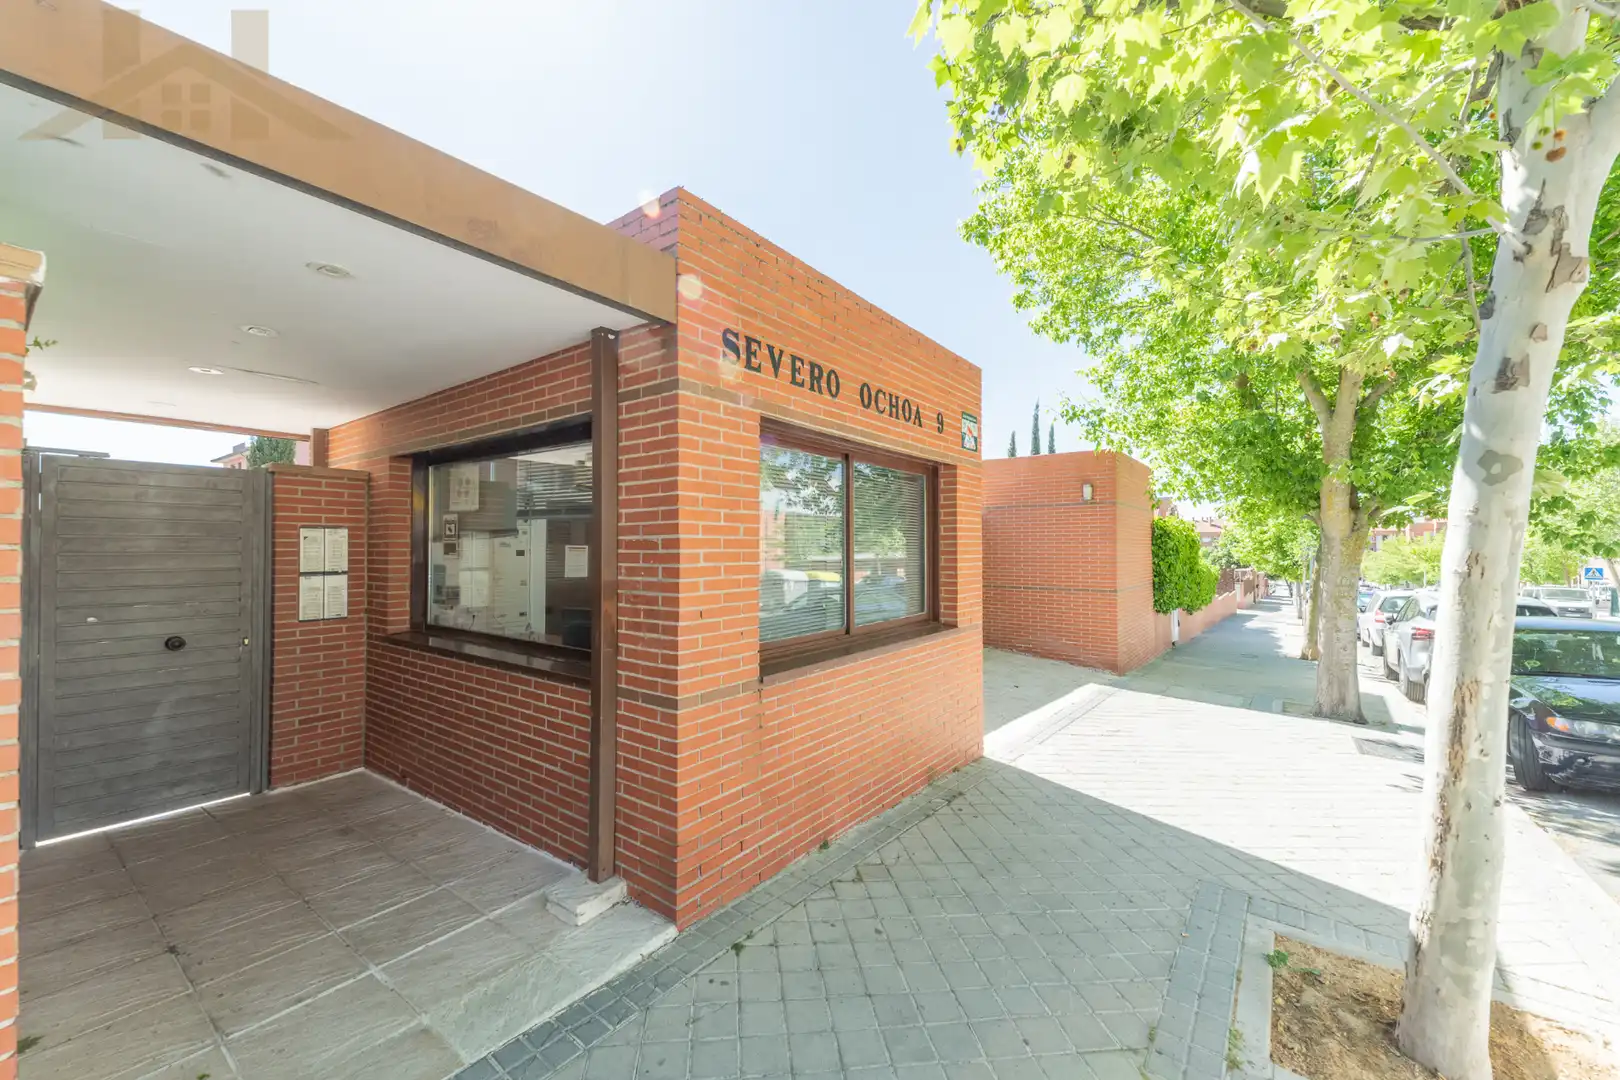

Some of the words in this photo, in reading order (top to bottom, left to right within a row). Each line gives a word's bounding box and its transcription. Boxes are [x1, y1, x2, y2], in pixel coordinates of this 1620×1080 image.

[721, 327, 841, 399] SEVERO
[859, 382, 923, 428] OCHOA
[936, 412, 945, 434] 9
